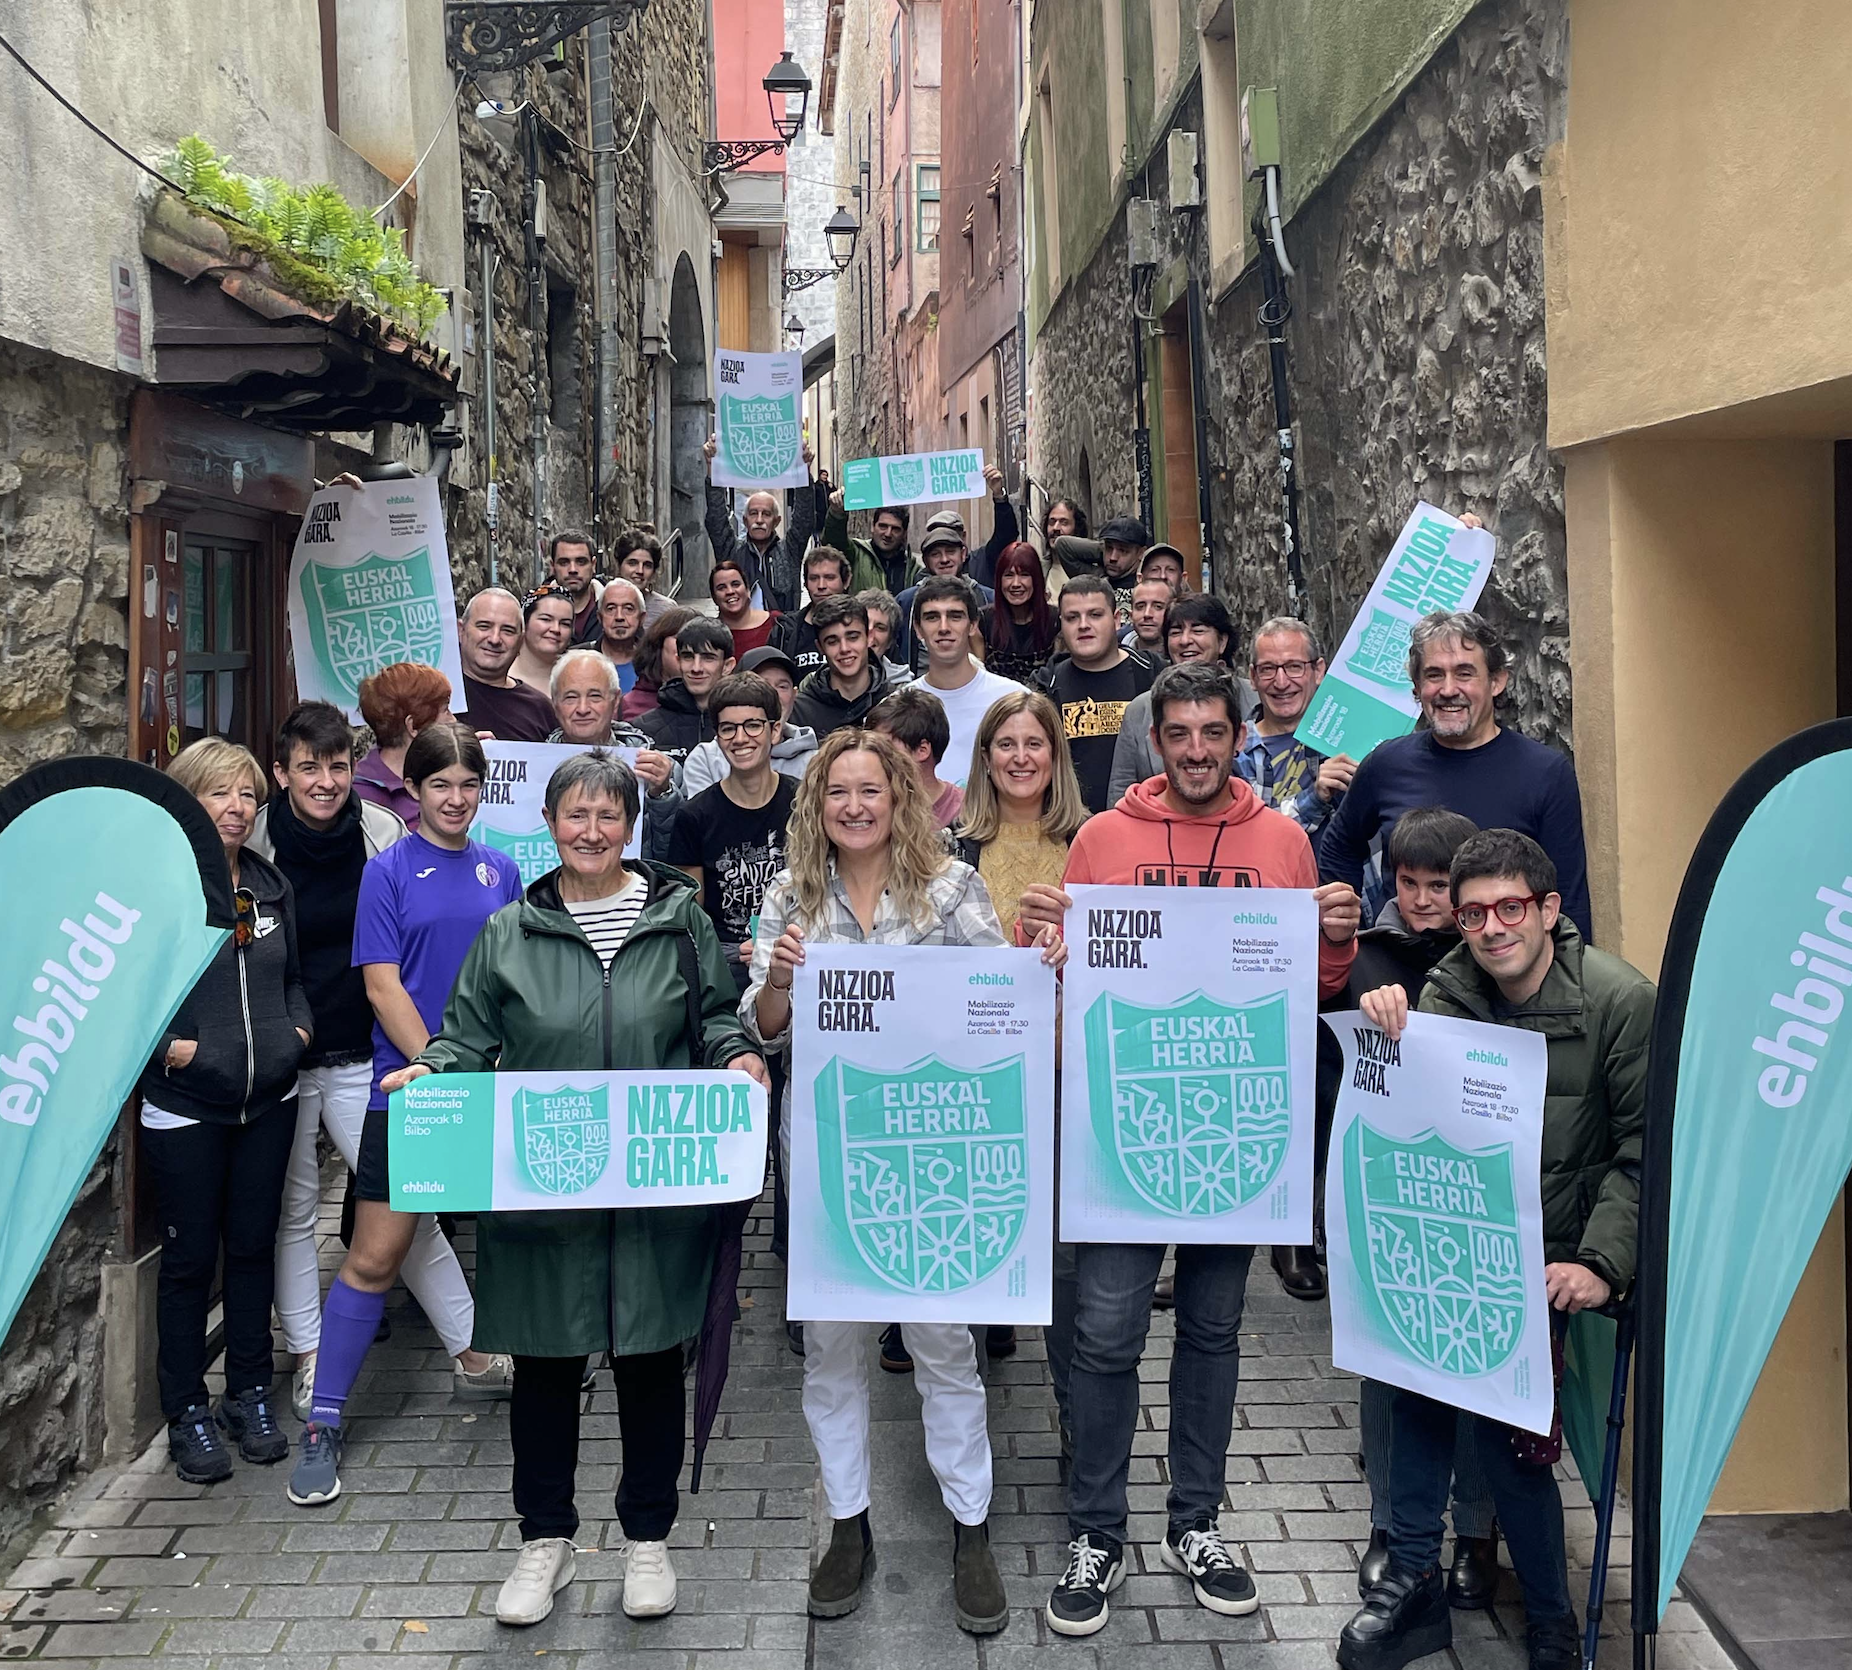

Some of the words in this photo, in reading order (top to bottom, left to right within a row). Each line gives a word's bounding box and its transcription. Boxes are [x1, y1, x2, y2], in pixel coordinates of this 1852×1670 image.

[720, 358, 745, 373] NAZIOA
[741, 402, 782, 413] EUSKAL
[742, 411, 783, 423] HERRIA
[929, 454, 978, 476] NAZIOA
[931, 474, 971, 495] GARA.
[309, 501, 341, 523] NAZIOA
[304, 522, 335, 544] GARA.
[1381, 516, 1456, 610] NAZIOA
[342, 564, 412, 590] EUSKAL
[346, 582, 414, 607] HERRIA
[1360, 621, 1382, 655] EUSKAL
[1368, 624, 1390, 659] HERRIA
[1314, 702, 1339, 739] Nazionala
[484, 759, 527, 782] AZIOA
[479, 782, 515, 804] ARA.
[514, 841, 561, 860] EUS
[1088, 908, 1162, 939] NAZIOA
[1233, 912, 1278, 925] ehbildu
[1232, 938, 1279, 947] Mobilizazio
[1232, 946, 1274, 954] Nazionala
[1088, 939, 1148, 969] GARA.
[1232, 957, 1260, 965] Azaroak
[1262, 957, 1269, 965] 18
[818, 969, 895, 1001] NAZIOA
[968, 972, 1014, 986] ehbildu
[1752, 875, 1852, 1109] ehbild
[0, 891, 142, 1126] ehbildu
[967, 1000, 1015, 1008] Mobilizazio
[967, 1008, 1010, 1016] Nazionala
[818, 1001, 880, 1032] GARA.
[1151, 1014, 1255, 1040] EUSKAL
[1152, 1040, 1256, 1067] HERRIA
[1352, 1027, 1402, 1068] NAZIOA
[1466, 1049, 1508, 1067] ehbildu
[1353, 1057, 1390, 1097] GARA.
[1463, 1076, 1507, 1092] Mobilizazio
[405, 1087, 470, 1098] Mobilizazio
[405, 1098, 463, 1109] Nazionala
[543, 1094, 594, 1109] EUSKAL
[882, 1079, 991, 1107] EUSKAL
[1462, 1085, 1502, 1100] Nazionala
[544, 1107, 594, 1122] HERRIA
[628, 1083, 753, 1135] NAZIOA
[1461, 1106, 1469, 1114] La
[1462, 1098, 1488, 1109] Azaroak
[1490, 1103, 1497, 1111] 18
[1501, 1105, 1519, 1115] 17:30
[404, 1113, 450, 1125] Azaroak
[452, 1113, 463, 1125] 18
[884, 1107, 992, 1134] HERRIA
[404, 1125, 431, 1136] Bilbo
[626, 1136, 729, 1188] GARA.
[1393, 1150, 1486, 1190] EUSKAL
[402, 1181, 445, 1193] ehbildu
[1396, 1178, 1488, 1217] HERRIA
